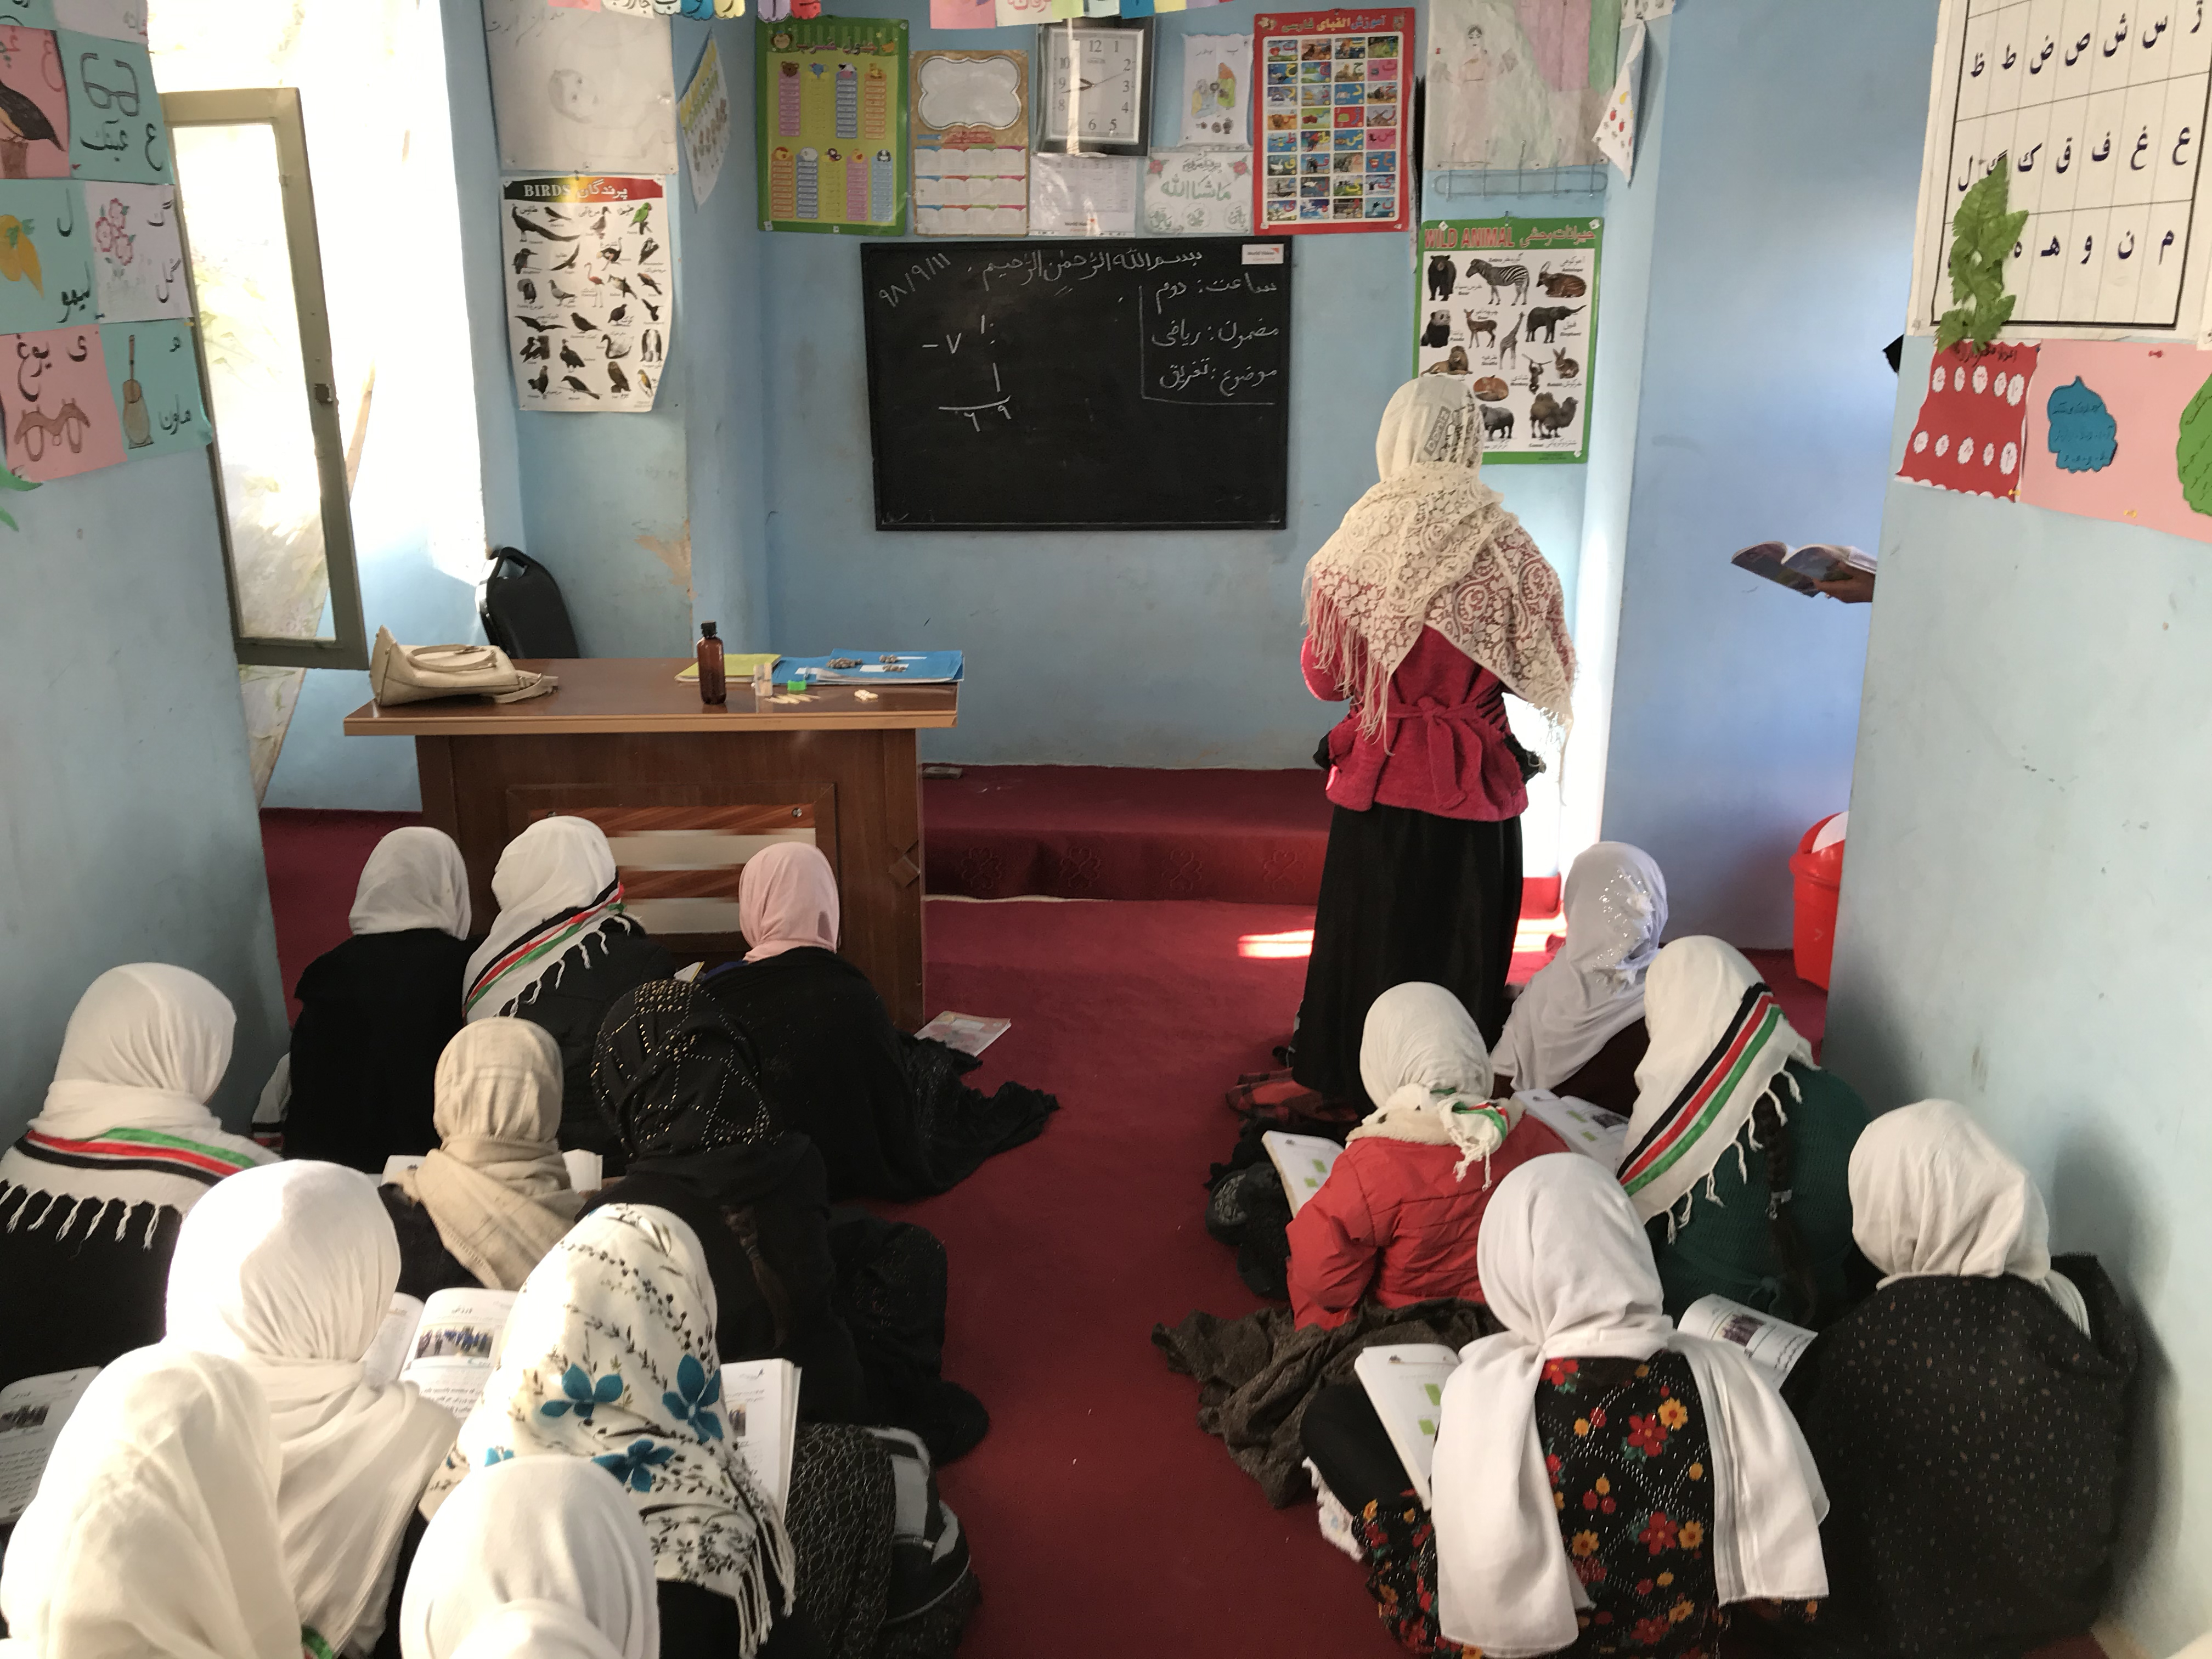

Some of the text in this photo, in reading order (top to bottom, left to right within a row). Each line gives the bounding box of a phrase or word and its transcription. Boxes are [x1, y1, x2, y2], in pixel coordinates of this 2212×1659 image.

[2103, 13, 2128, 58] ش
[2142, 15, 2168, 49] س
[1089, 40, 1102, 53] 12
[1114, 40, 1119, 53] 1
[2001, 43, 2017, 70] ط
[2030, 35, 2054, 75] ض
[2065, 32, 2091, 66] ص
[1123, 59, 1131, 71] 2
[1971, 52, 1985, 78] ظ
[1059, 77, 1065, 89] 9
[1122, 80, 1130, 92] 3
[1058, 99, 1065, 111] 8
[1121, 101, 1129, 113] 4
[1088, 119, 1097, 131] 6
[1109, 119, 1117, 131] 5
[2056, 137, 2073, 174] ق
[2092, 131, 2111, 162] ف
[2130, 125, 2149, 171] غ
[2172, 126, 2191, 166] ع
[1957, 154, 1973, 192] ل
[523, 184, 571, 197] BIRDS
[577, 178, 629, 200] پرندگان
[1424, 226, 1515, 248] WILD ANIMAL
[1520, 224, 1596, 248] حیوانات وحشی
[2118, 229, 2135, 260] ن
[2158, 229, 2175, 266] م
[2080, 234, 2093, 265] و
[1156, 281, 1187, 314] دوم
